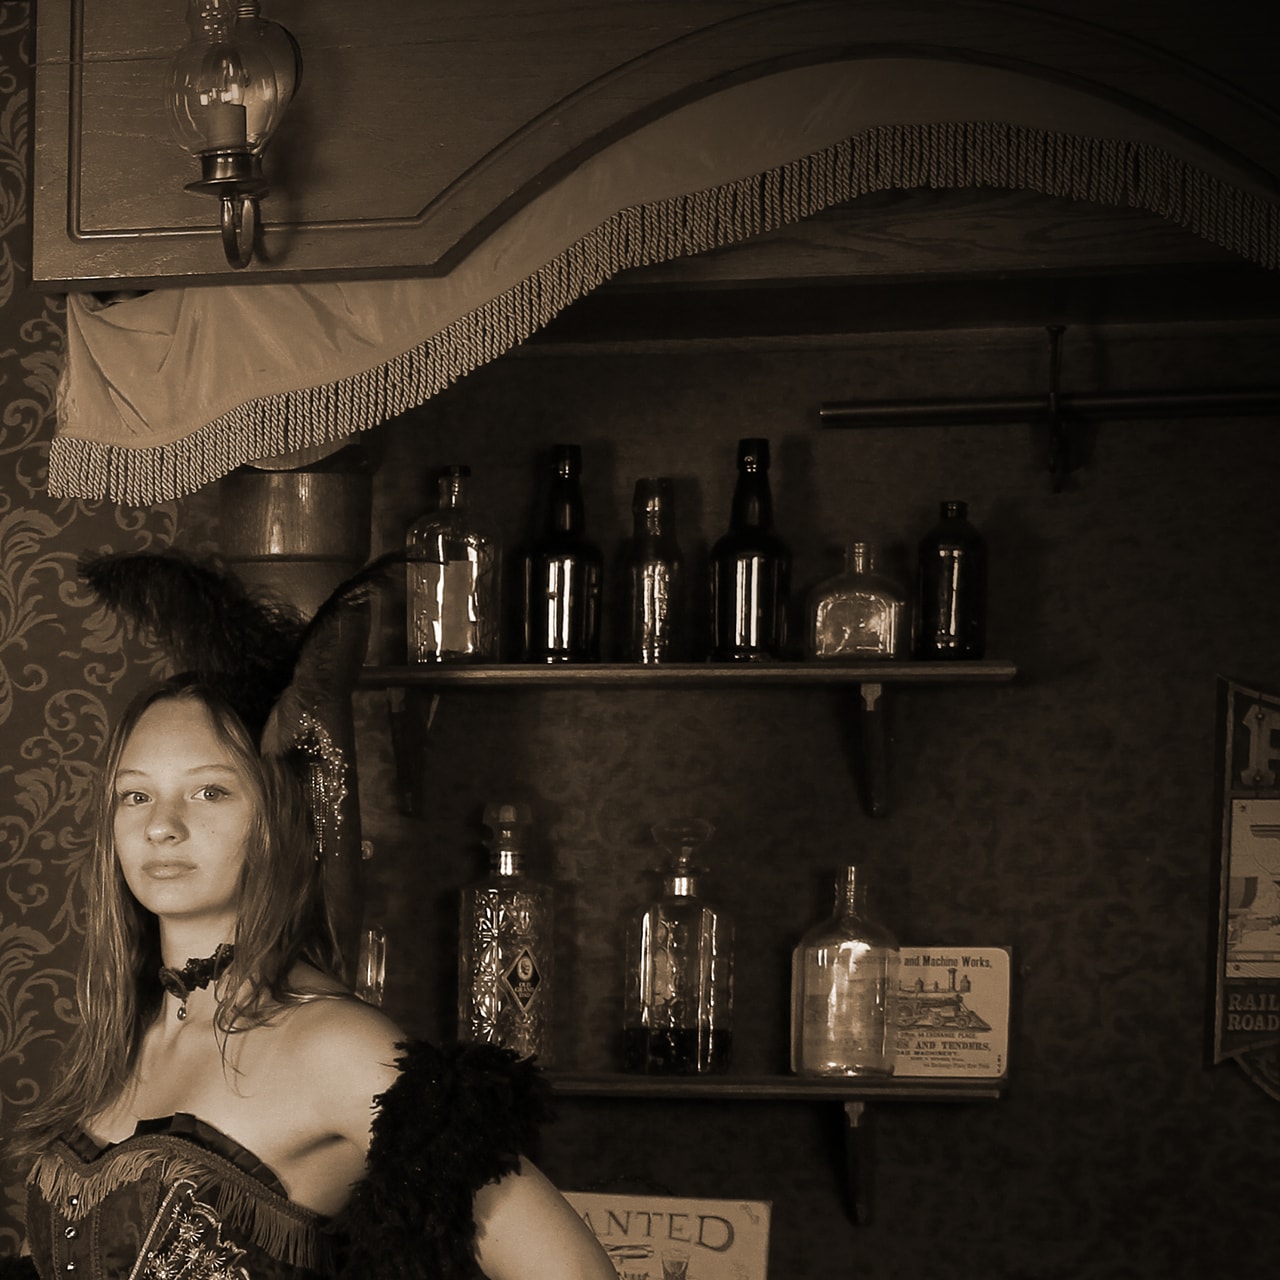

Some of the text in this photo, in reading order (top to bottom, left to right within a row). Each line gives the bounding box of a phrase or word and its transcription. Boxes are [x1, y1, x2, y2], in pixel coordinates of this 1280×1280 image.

[903, 956, 920, 967] and
[922, 955, 959, 967] Machine
[1227, 992, 1280, 1012] RAIL
[1226, 1013, 1280, 1032] ROAD
[915, 1041, 936, 1050] AND
